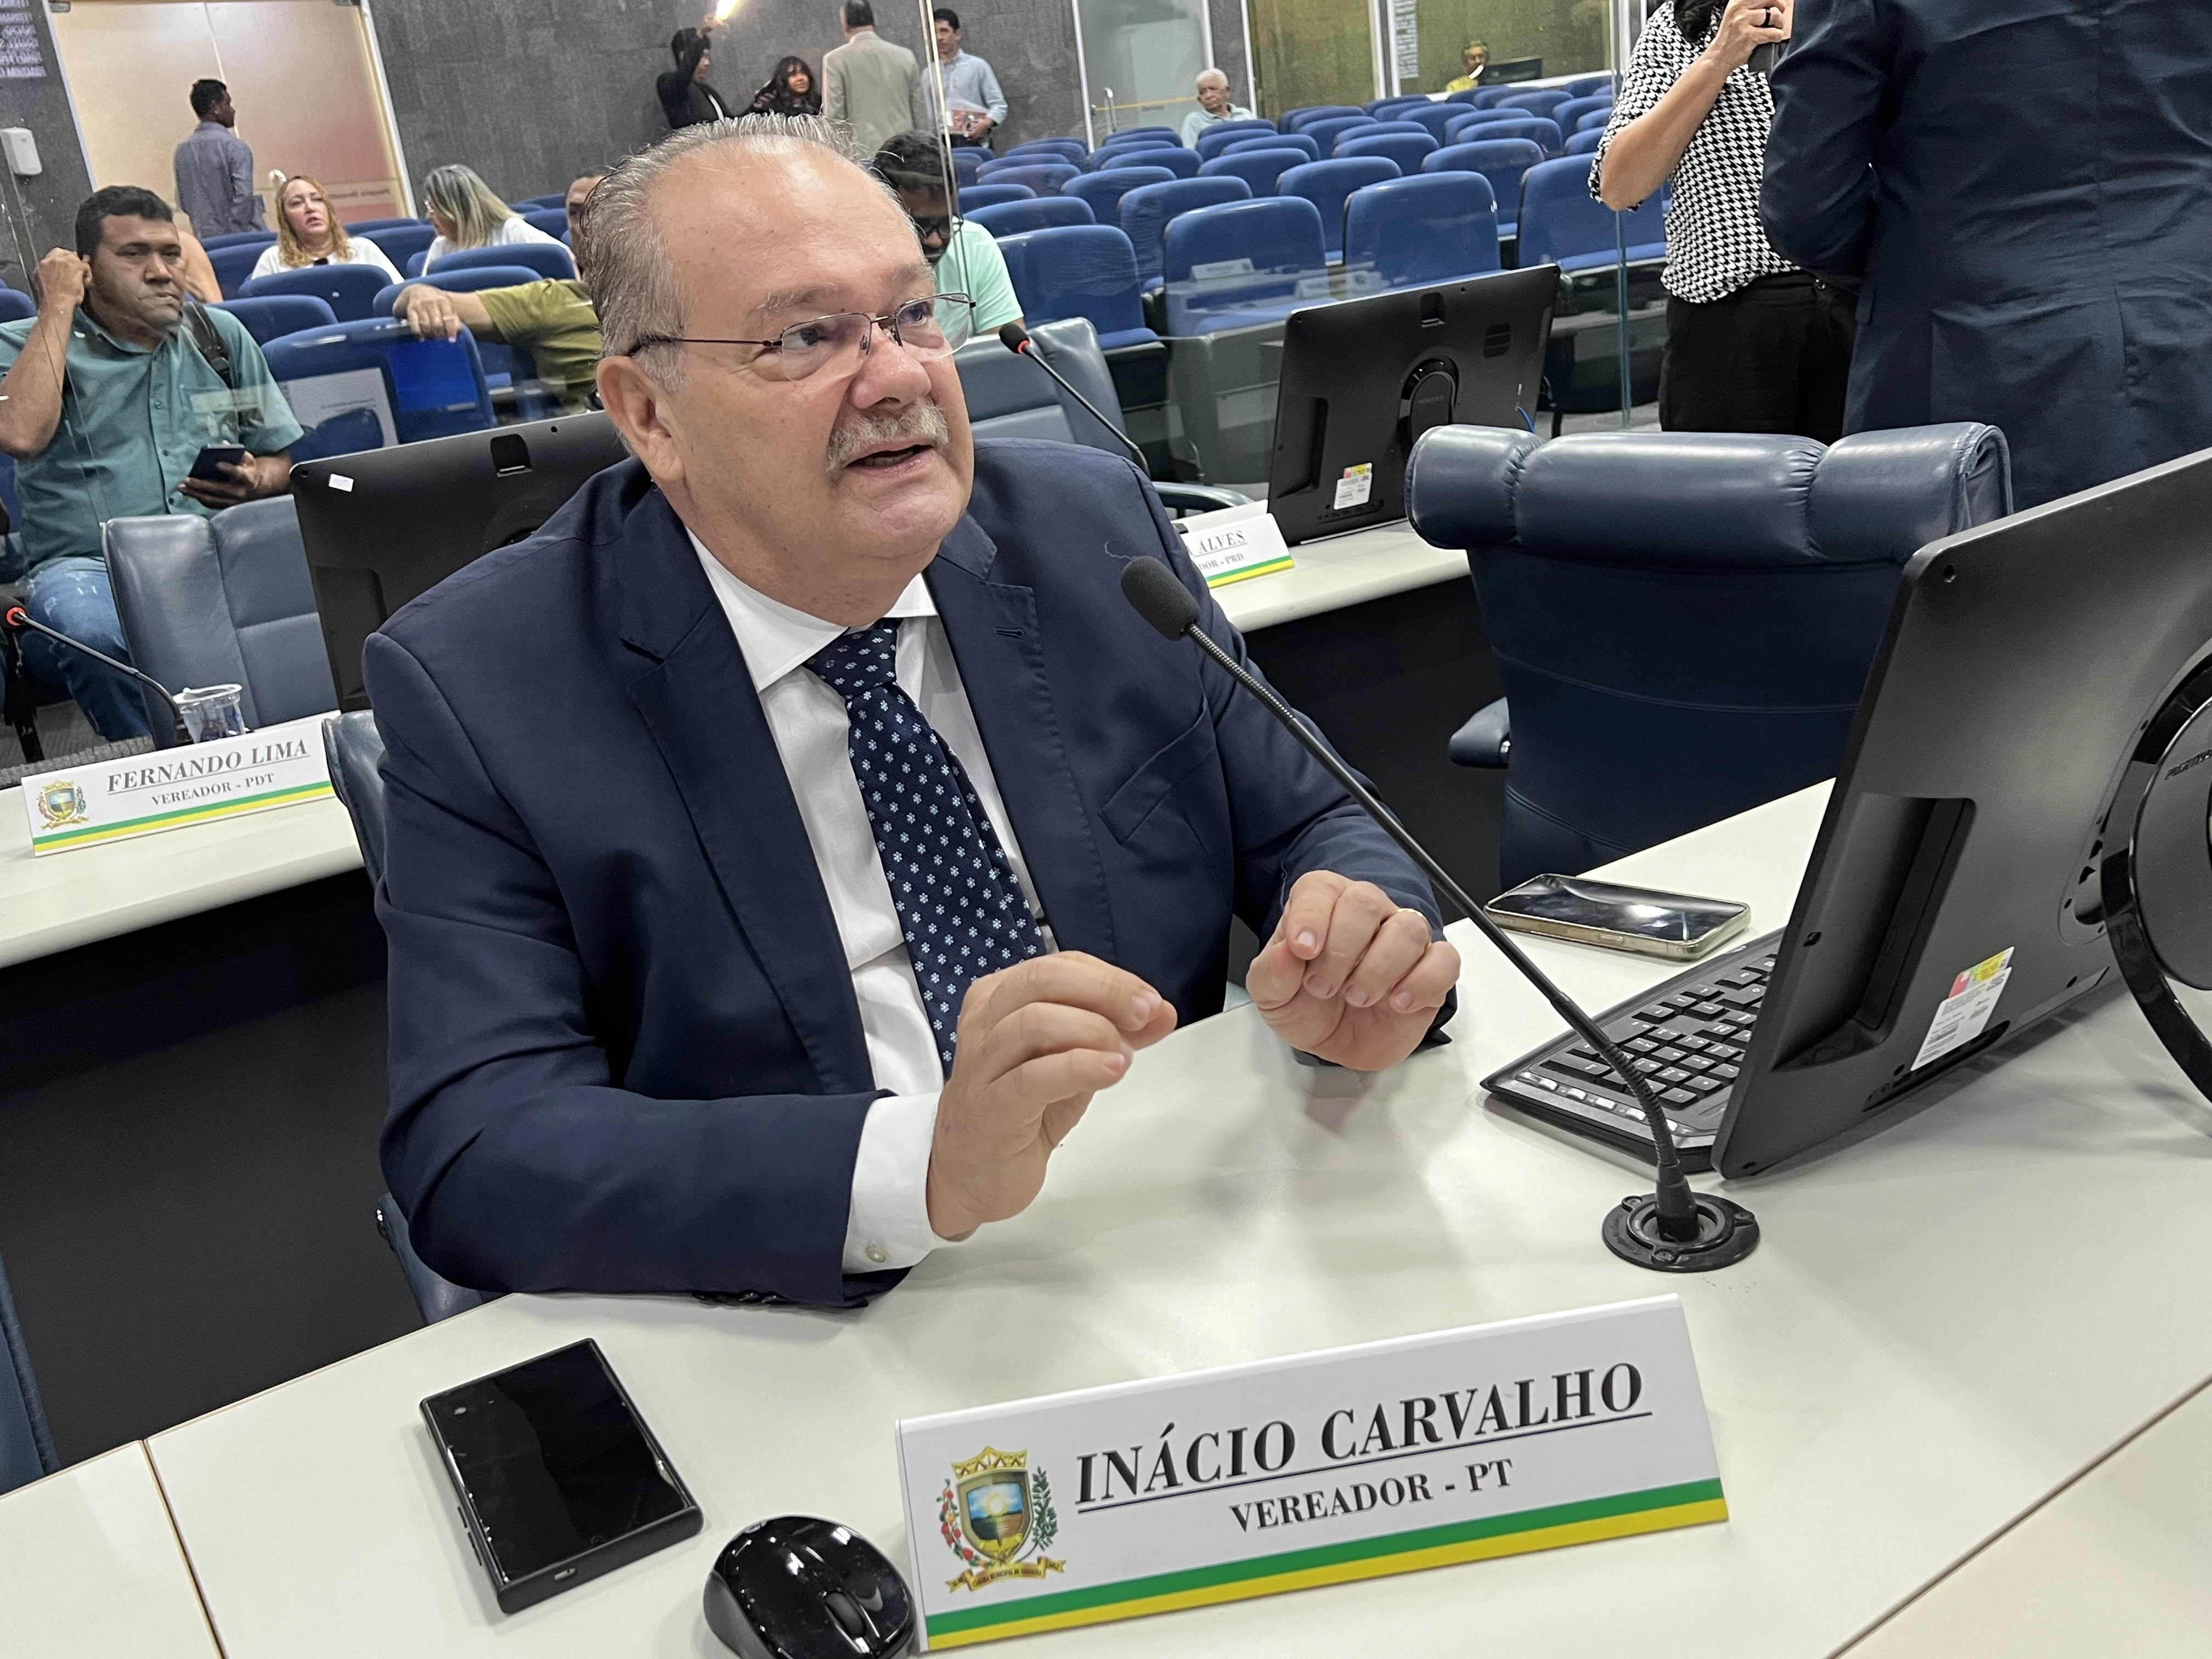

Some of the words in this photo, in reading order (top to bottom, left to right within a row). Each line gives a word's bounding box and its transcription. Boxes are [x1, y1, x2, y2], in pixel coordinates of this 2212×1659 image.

[1198, 559, 1219, 571] DOR
[1224, 552, 1244, 565] PRD
[1199, 530, 1245, 554] ALVES
[108, 751, 242, 793] FERNANDO
[251, 739, 308, 765] LIMA
[151, 781, 232, 806] VEREADOR
[245, 772, 275, 788] PDT
[1075, 1420, 1296, 1505] INÁCIO
[1321, 1362, 1643, 1460] CARVALHO
[1228, 1472, 1434, 1532] VEREADOR
[1464, 1458, 1514, 1493] PT
